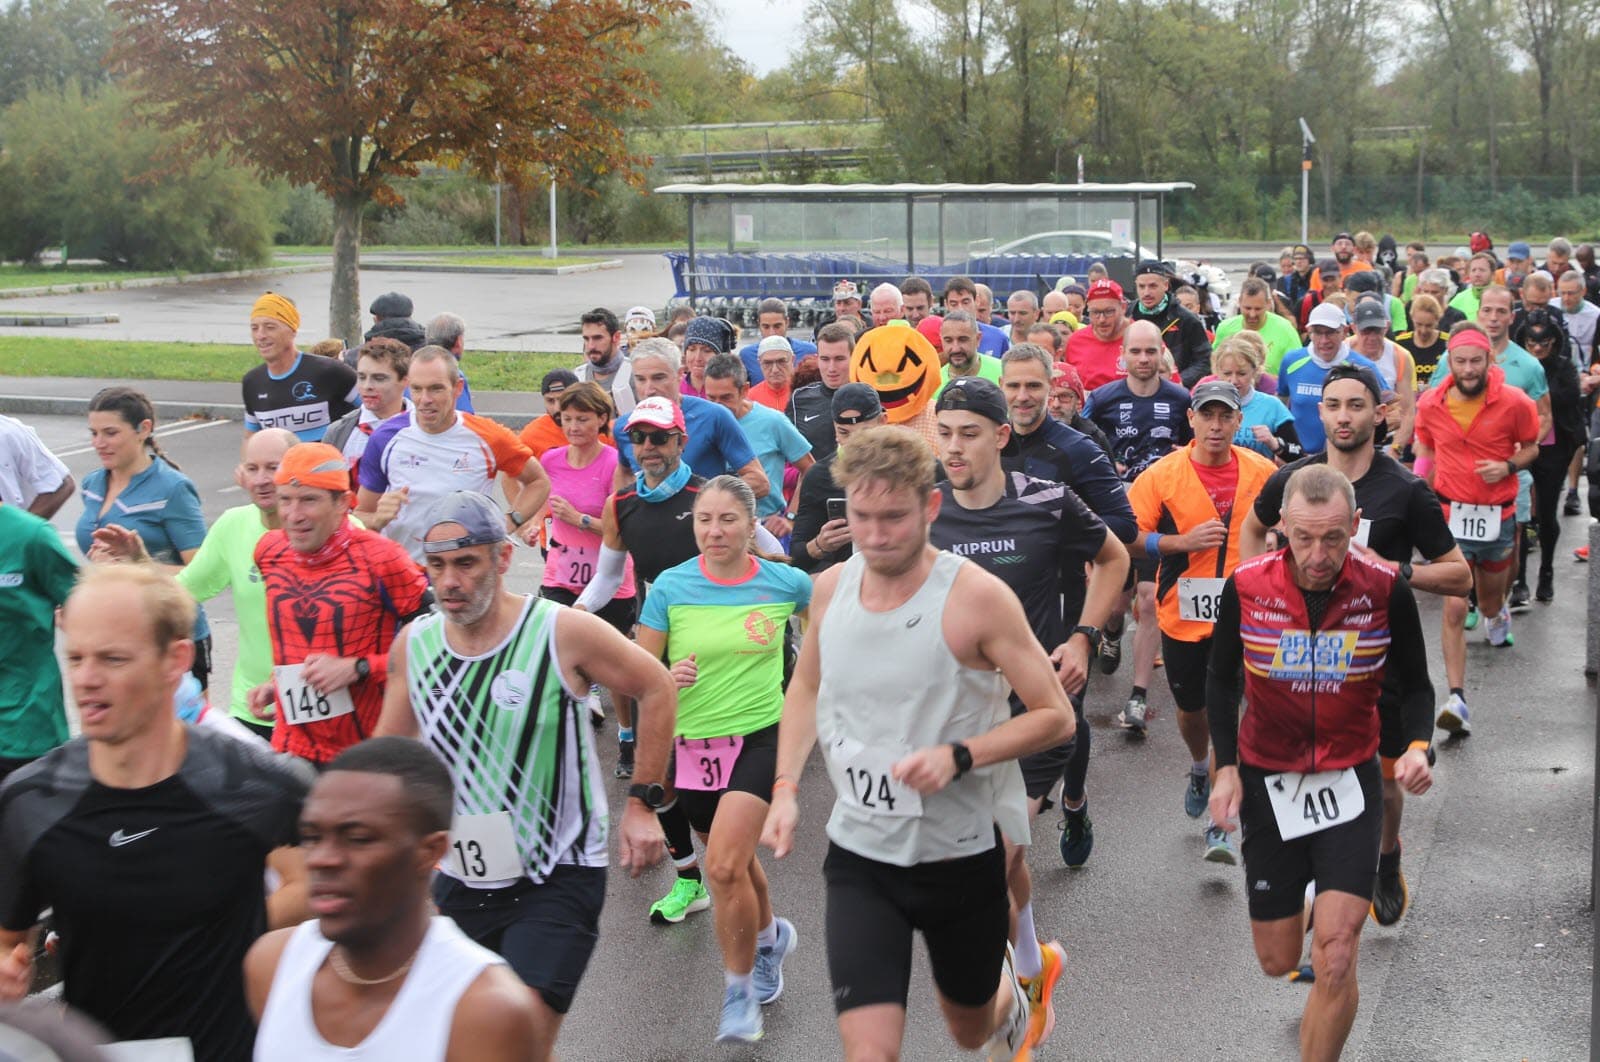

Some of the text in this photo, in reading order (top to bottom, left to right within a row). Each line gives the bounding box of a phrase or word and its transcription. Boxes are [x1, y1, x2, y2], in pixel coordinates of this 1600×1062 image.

[1462, 517, 1487, 538] 116
[952, 538, 1016, 556] KIPRUN
[569, 562, 592, 585] 20
[1191, 594, 1223, 619] 138
[1282, 650, 1352, 666] CASH
[286, 685, 331, 721] 148
[700, 756, 722, 788] 31
[846, 767, 896, 810] 124
[1303, 787, 1341, 825] 40
[453, 839, 488, 878] 13
